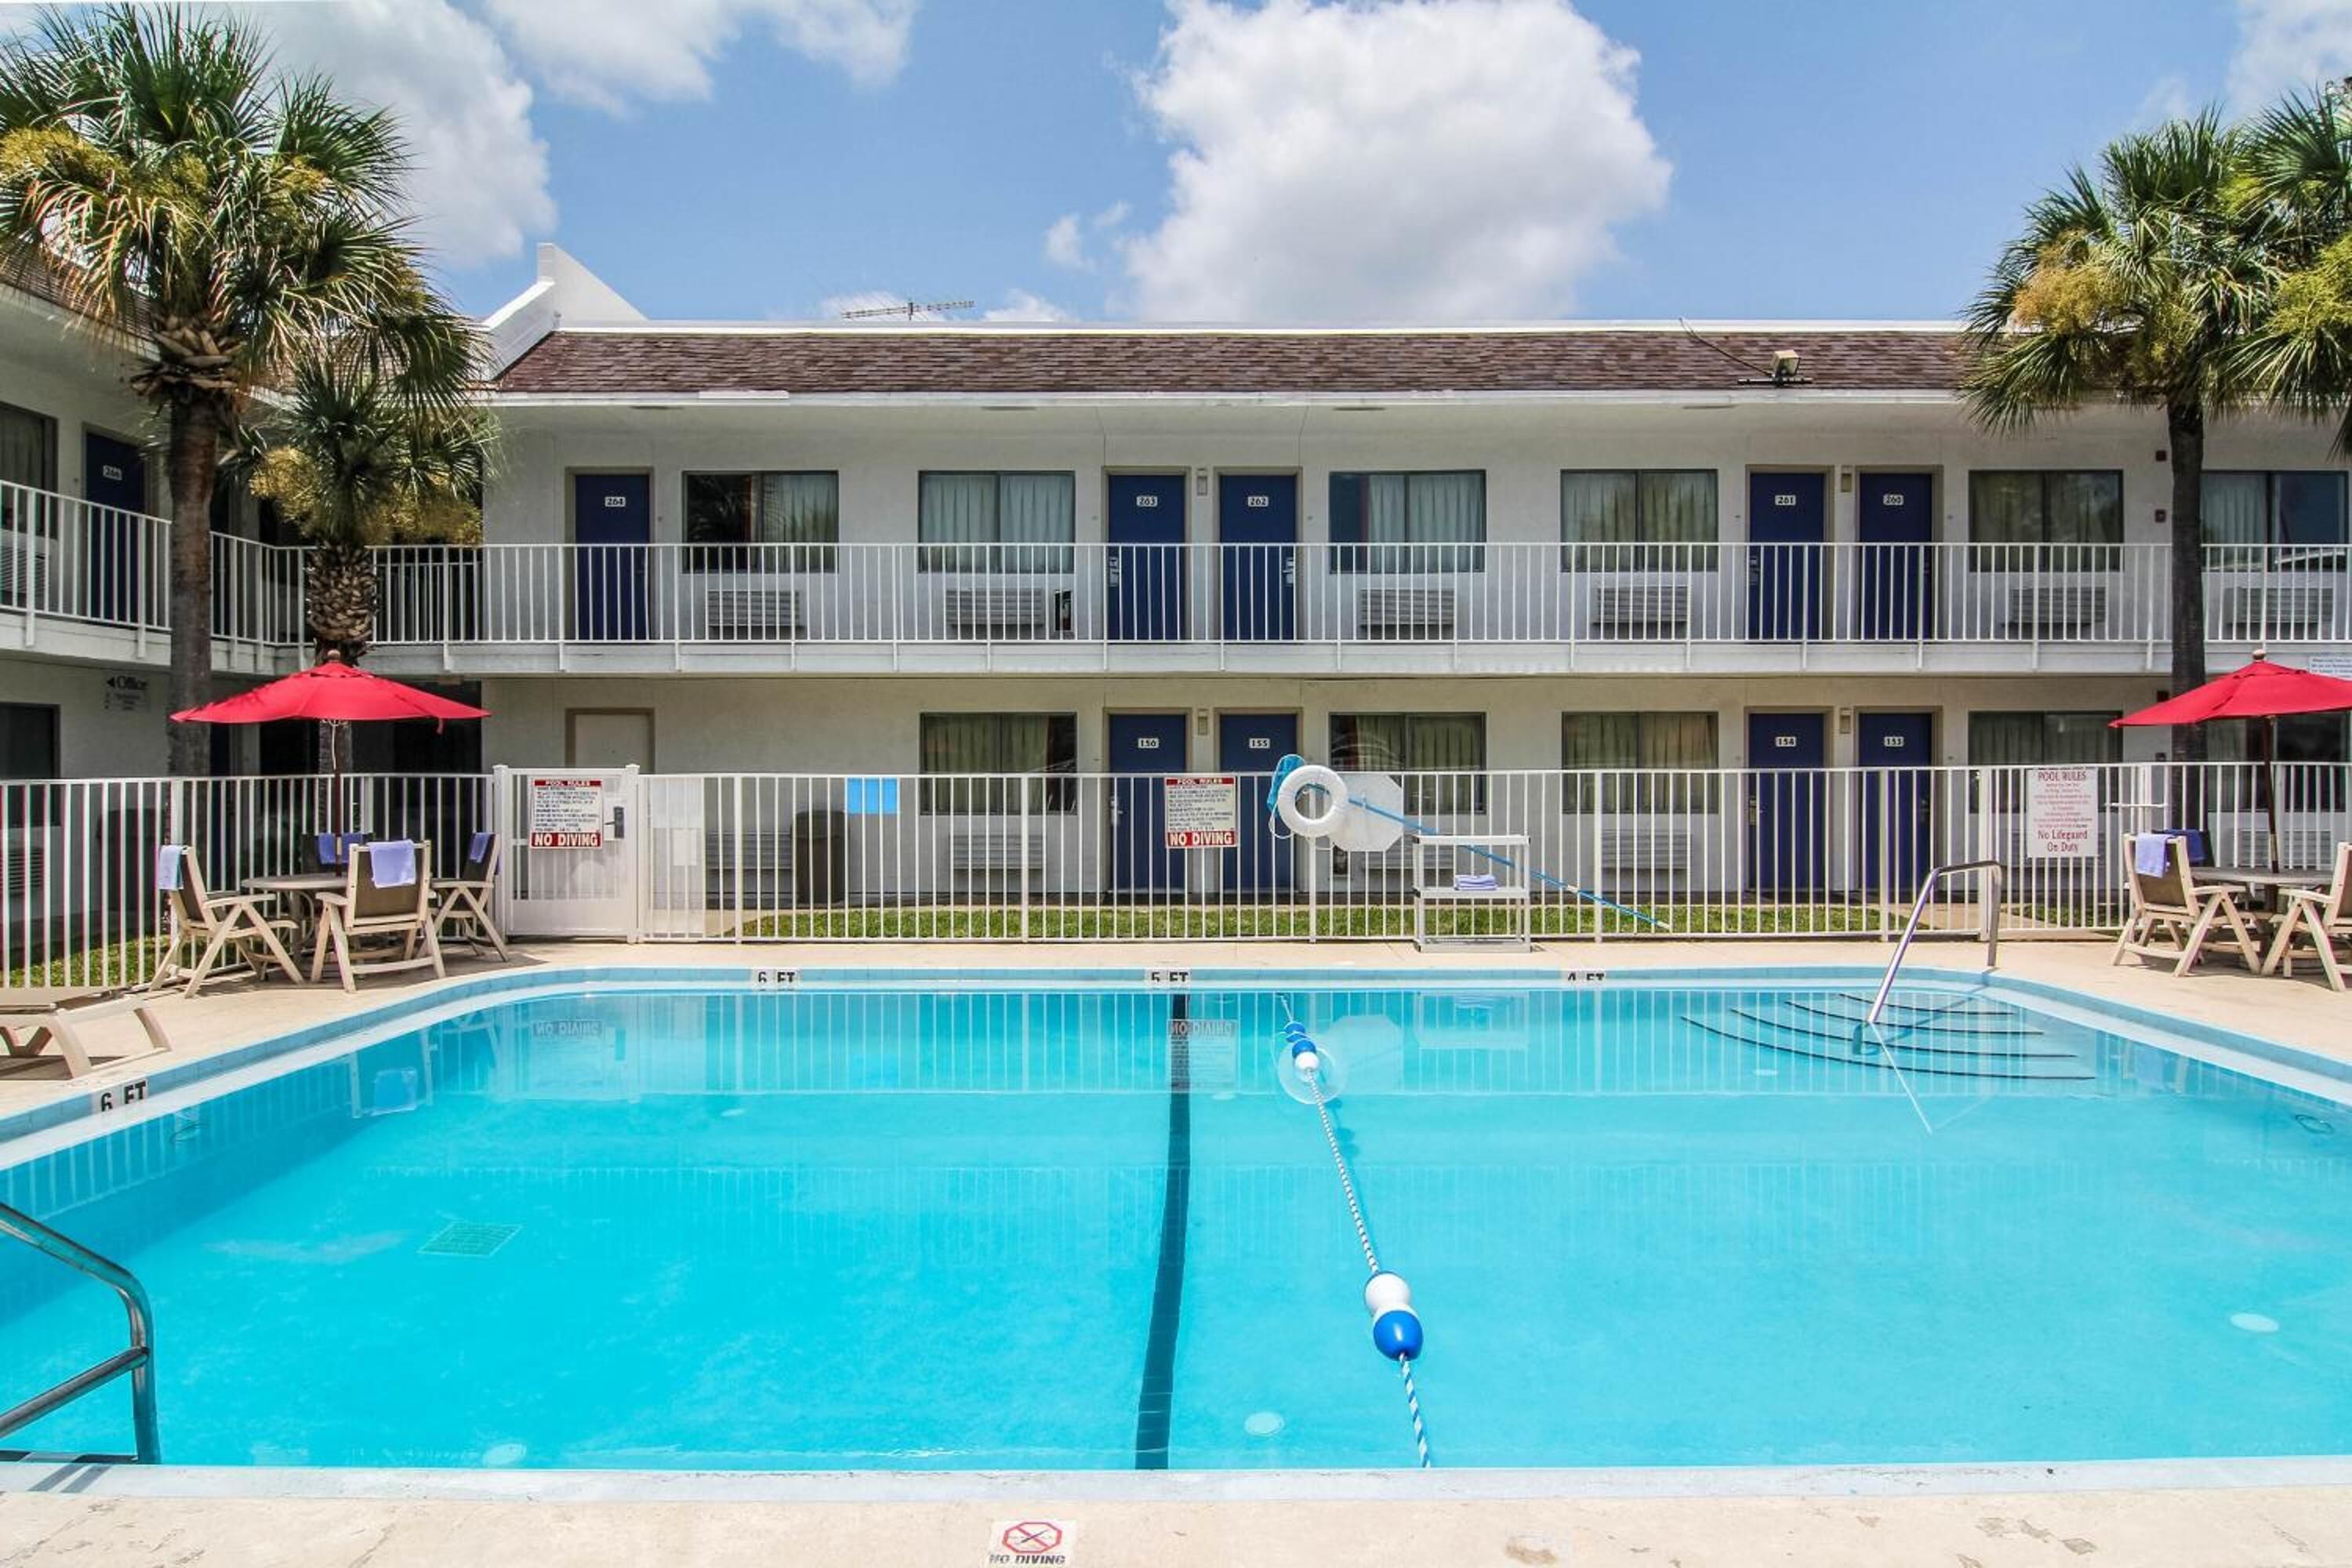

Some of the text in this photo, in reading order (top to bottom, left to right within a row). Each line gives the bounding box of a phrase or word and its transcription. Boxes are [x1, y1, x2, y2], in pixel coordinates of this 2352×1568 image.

[116, 676, 148, 691] Office
[2038, 771, 2086, 782] POOL RULES
[535, 833, 598, 846] NO DIVING
[1169, 832, 1232, 846] NO DIVING
[2038, 829, 2050, 840] No
[2047, 841, 2078, 852] On Duty
[757, 971, 796, 983] 6 FT
[1151, 971, 1189, 982] 5 FT
[100, 1080, 147, 1112] 6 FT
[989, 1554, 1066, 1565] NO DIVING
